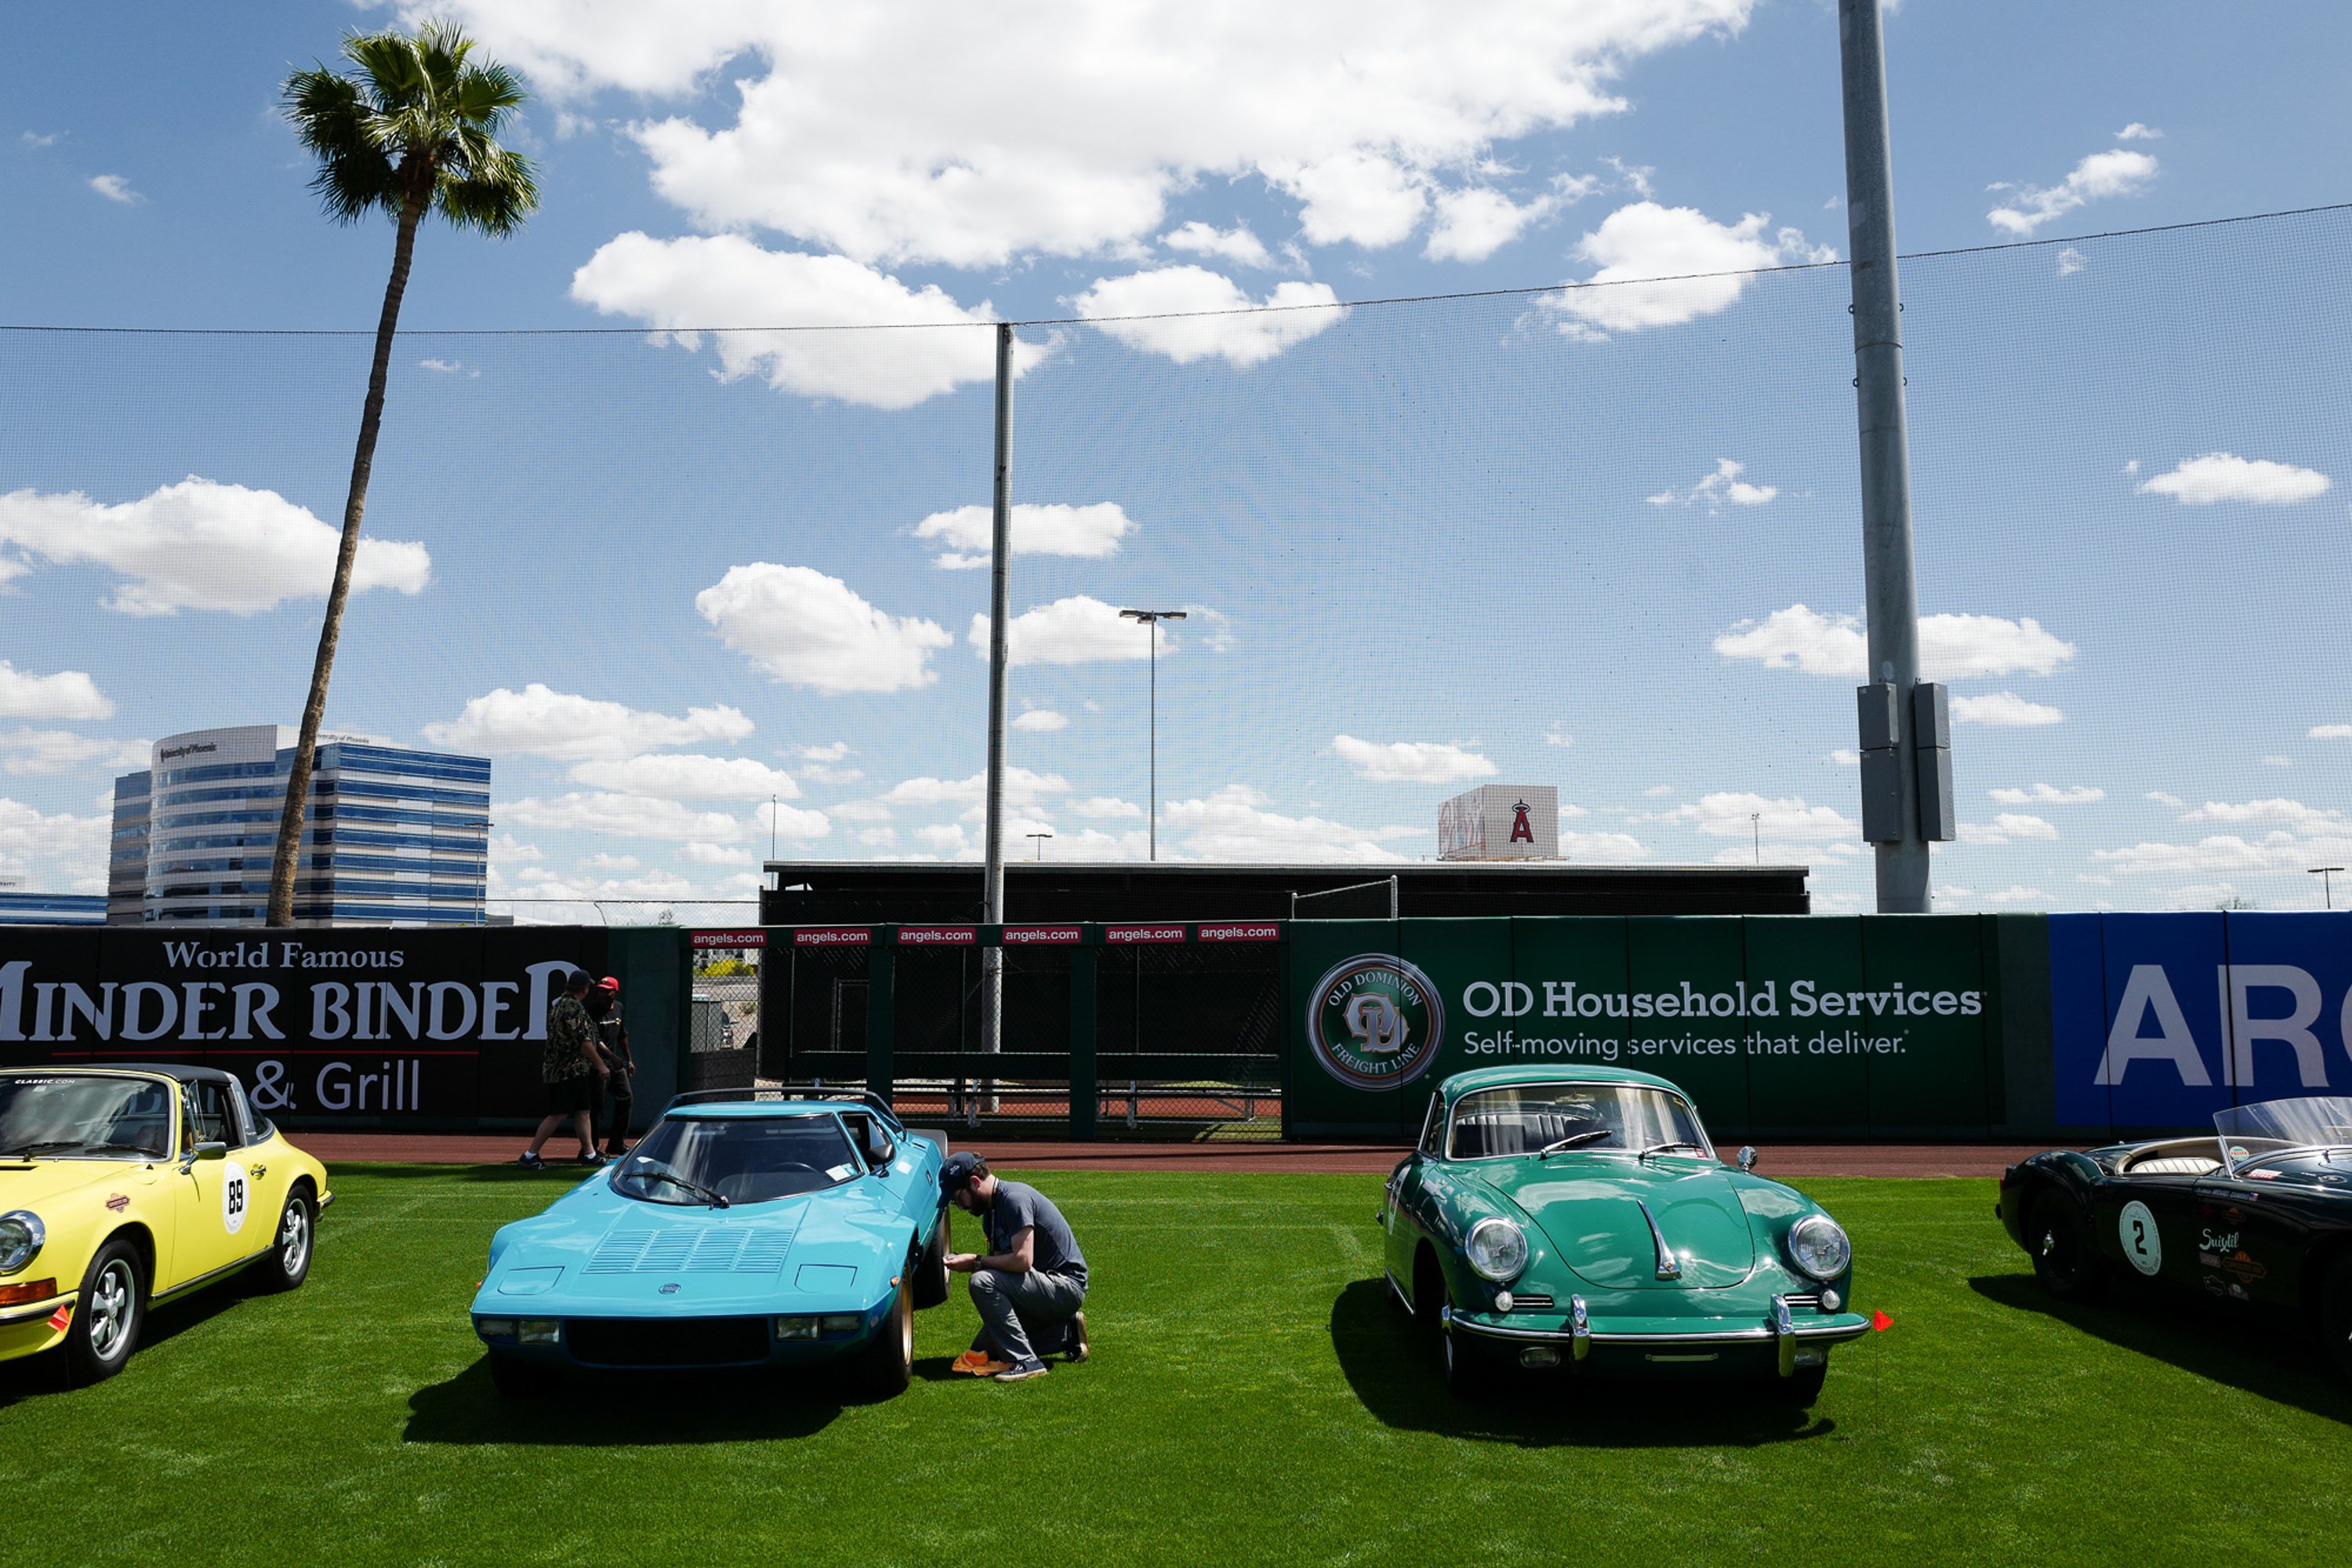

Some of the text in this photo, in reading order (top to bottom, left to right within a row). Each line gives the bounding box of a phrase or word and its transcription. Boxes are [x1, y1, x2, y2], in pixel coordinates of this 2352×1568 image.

[693, 933, 764, 944] angels.com
[797, 931, 868, 944] angels.com
[900, 930, 973, 943] angels.com
[1005, 929, 1078, 942] angels.com
[1109, 928, 1183, 941] angels.com
[1201, 927, 1276, 939] angels.com
[163, 942, 405, 968] World Famous
[1328, 972, 1423, 1007] OLD DOMINION
[1463, 979, 1982, 1018] OD Household Services
[2092, 964, 2352, 1087] AR
[1331, 1043, 1421, 1074] FREIGHT LINE
[1464, 1029, 1905, 1062] Self-moving services that deliver.
[250, 1060, 296, 1110] &
[316, 1059, 419, 1111] Grill
[229, 1178, 243, 1214] 89
[2132, 1220, 2147, 1255] 2
